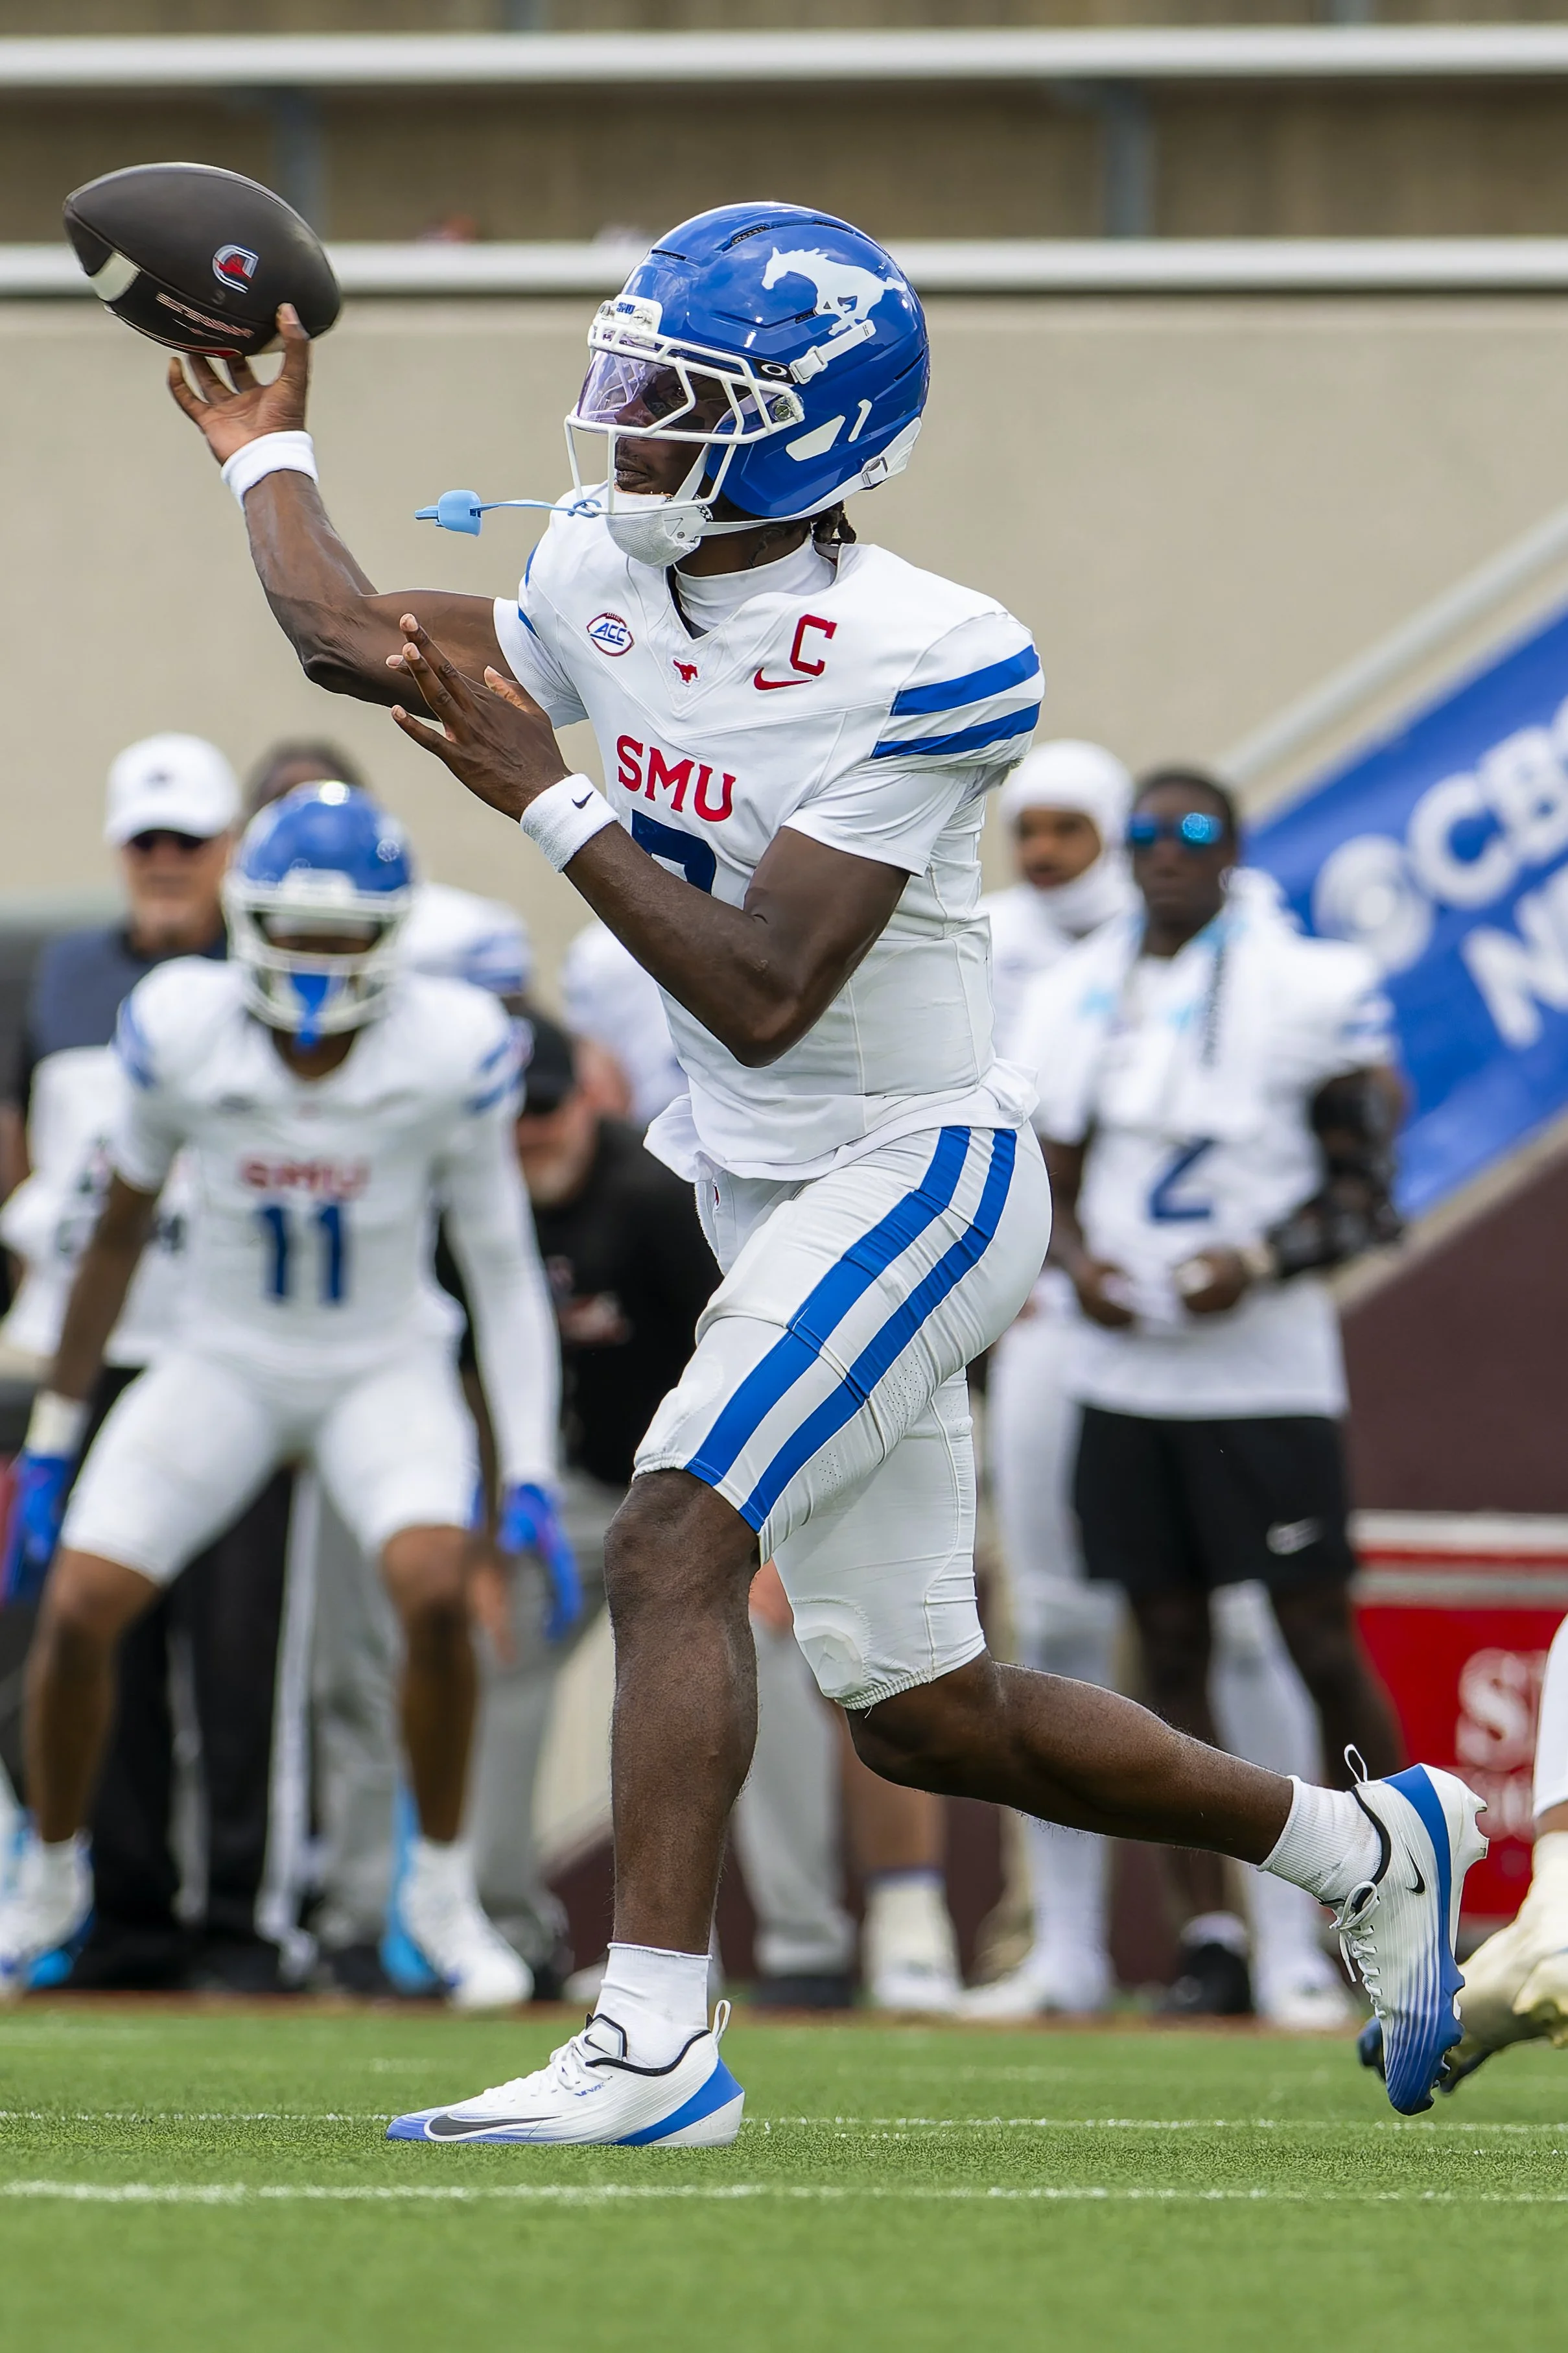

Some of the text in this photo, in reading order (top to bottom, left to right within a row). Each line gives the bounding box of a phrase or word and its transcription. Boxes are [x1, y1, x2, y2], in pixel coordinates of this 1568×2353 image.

[616, 302, 635, 315] SMU
[593, 622, 627, 643] ACC
[790, 613, 837, 677] C
[616, 735, 736, 822] SMU
[1407, 694, 1568, 909] CB
[254, 1201, 351, 1306] 11
